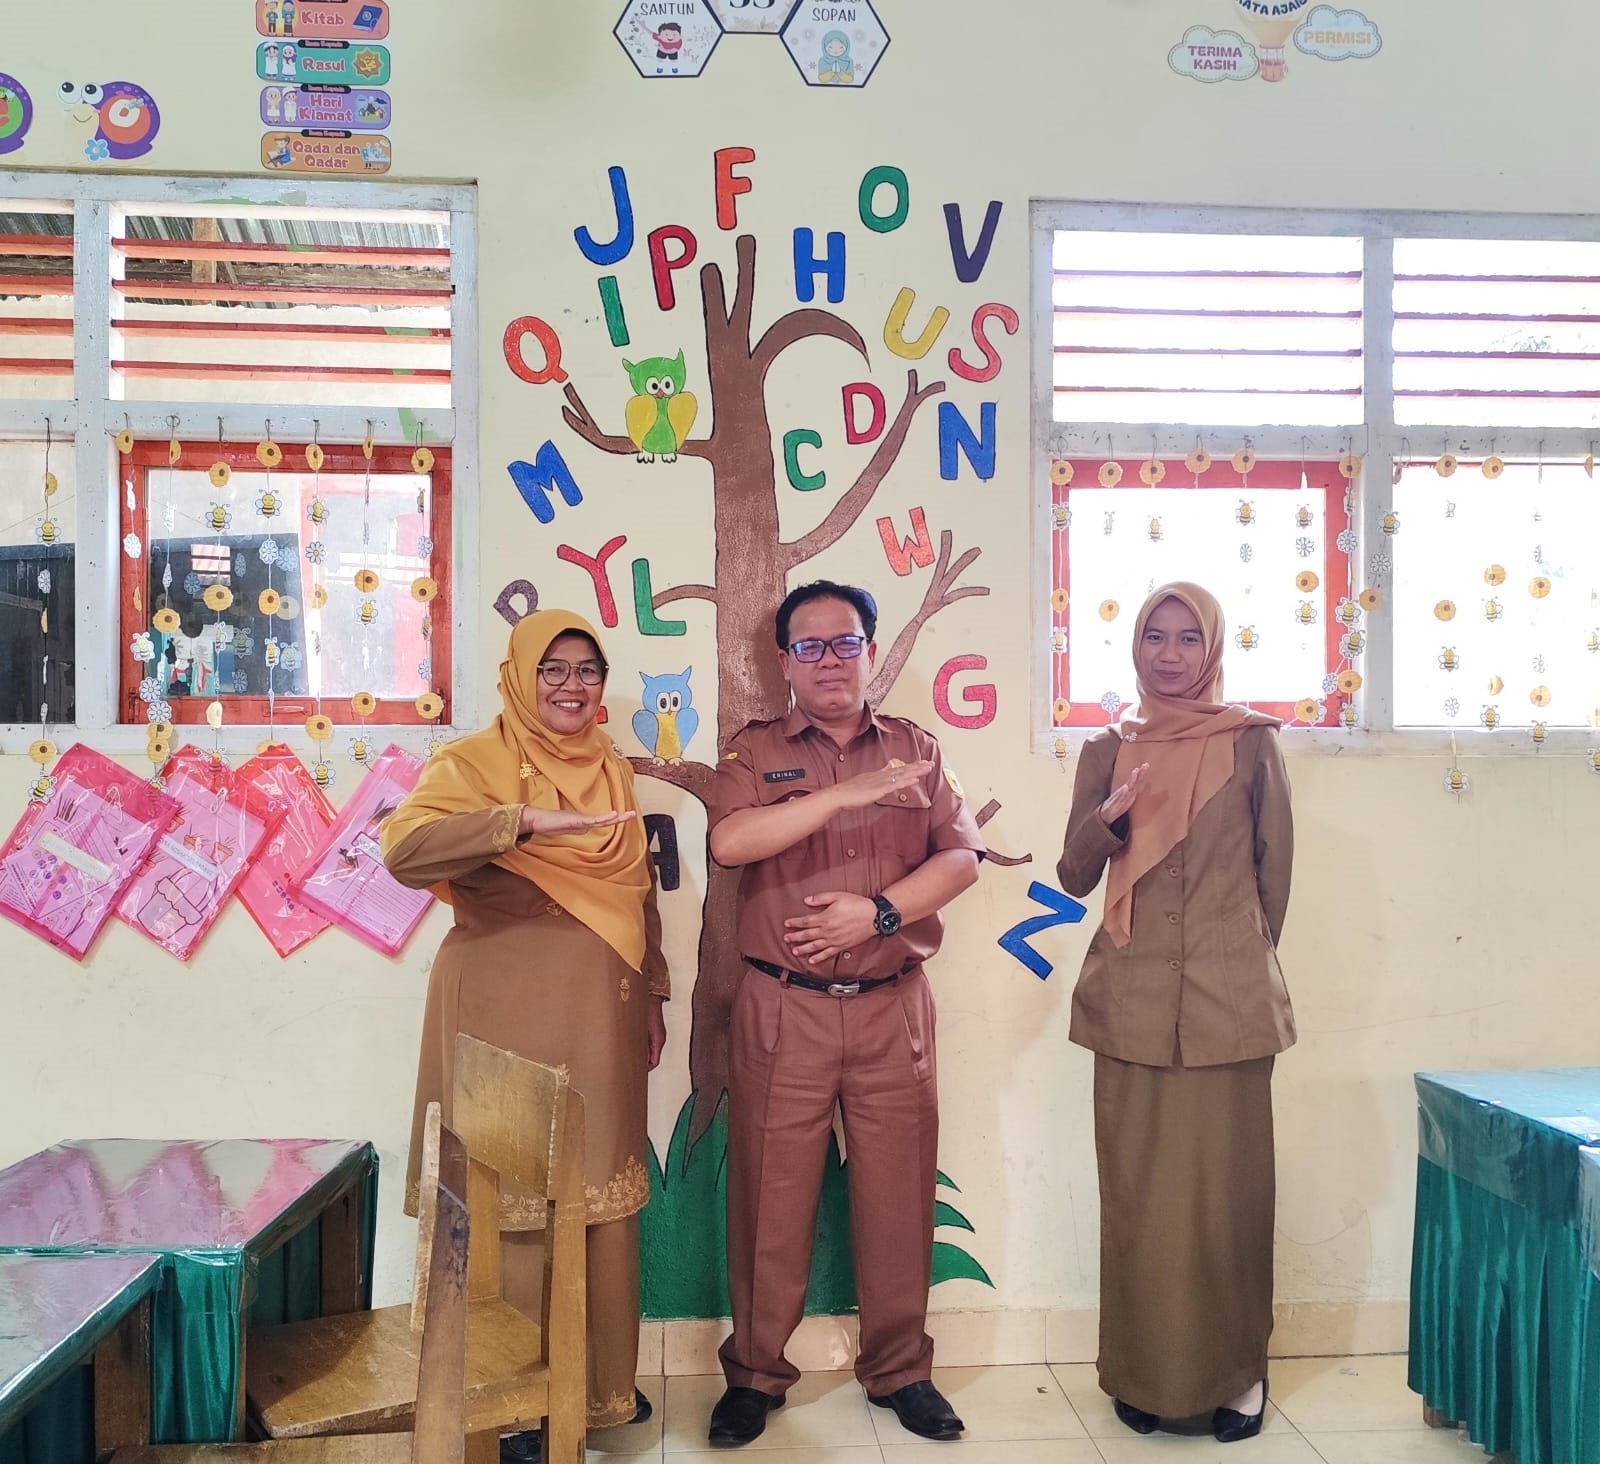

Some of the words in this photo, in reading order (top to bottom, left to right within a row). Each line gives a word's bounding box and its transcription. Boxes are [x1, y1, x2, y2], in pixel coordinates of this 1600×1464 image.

[301, 10, 344, 26] Kitab
[640, 2, 695, 16] SANTUN
[812, 8, 856, 22] SOPAN
[1304, 30, 1372, 46] PERMISI
[302, 57, 346, 72] Rasul
[1187, 44, 1243, 58] TERIMA
[1192, 58, 1237, 72] KASIH
[310, 93, 342, 107] Hari
[292, 140, 331, 155] Qada
[334, 143, 361, 155] dan
[304, 154, 349, 169] Qadar
[574, 166, 634, 265] J
[714, 147, 756, 231] F
[858, 165, 910, 233] O
[647, 225, 697, 311] P
[793, 227, 846, 304] H
[943, 200, 1003, 283] V
[597, 275, 630, 347] I
[883, 286, 950, 360] U
[948, 302, 1019, 383] S
[503, 315, 568, 384] Q
[841, 382, 886, 445] D
[938, 401, 996, 480] N
[507, 439, 583, 524] M
[783, 428, 826, 492] C
[876, 506, 936, 576] W
[556, 535, 627, 628] Y
[631, 558, 687, 637] L
[933, 654, 998, 730] G
